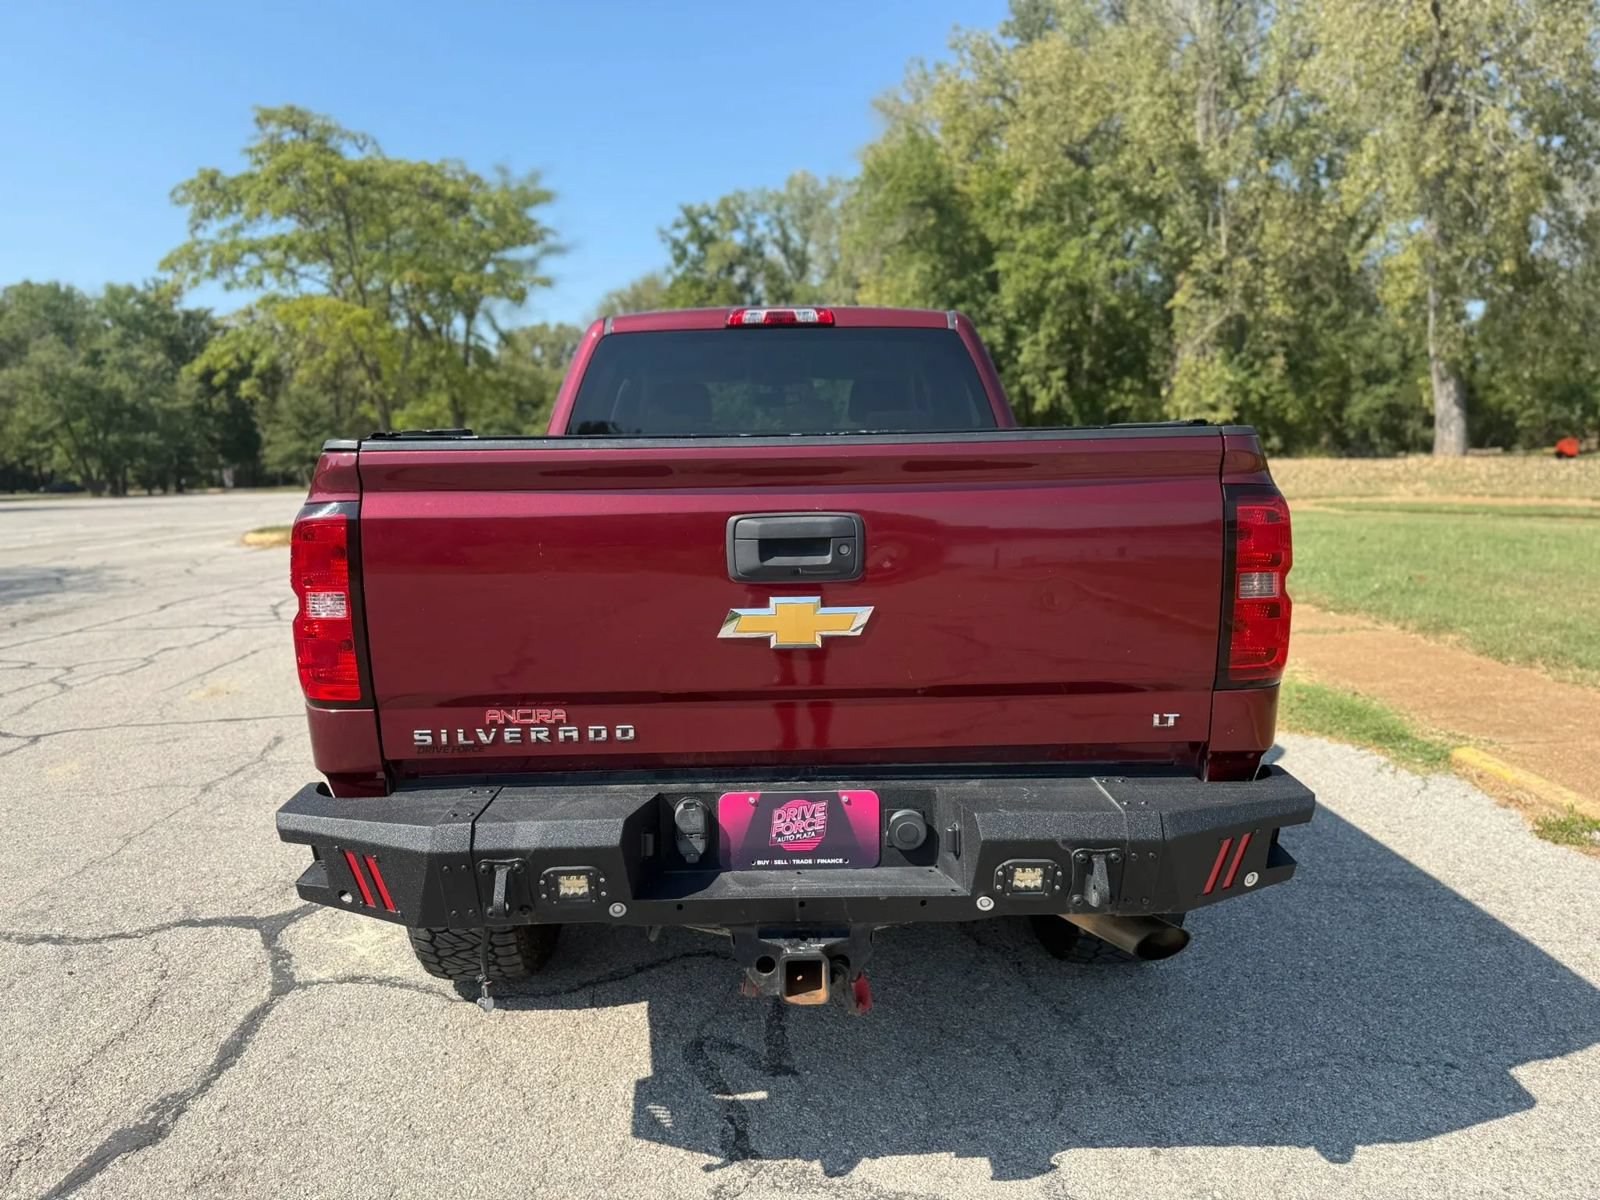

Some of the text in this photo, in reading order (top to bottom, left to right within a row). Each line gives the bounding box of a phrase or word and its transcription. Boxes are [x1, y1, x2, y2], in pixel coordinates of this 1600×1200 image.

[485, 708, 567, 724] ANCIRA
[1153, 713, 1180, 727] LT
[413, 725, 636, 745] SILVERADO
[416, 744, 485, 755] DRIVE FORCE
[773, 802, 827, 824] DRIVE
[771, 816, 827, 837] FORCE
[776, 831, 816, 843] AUTO PLAZA
